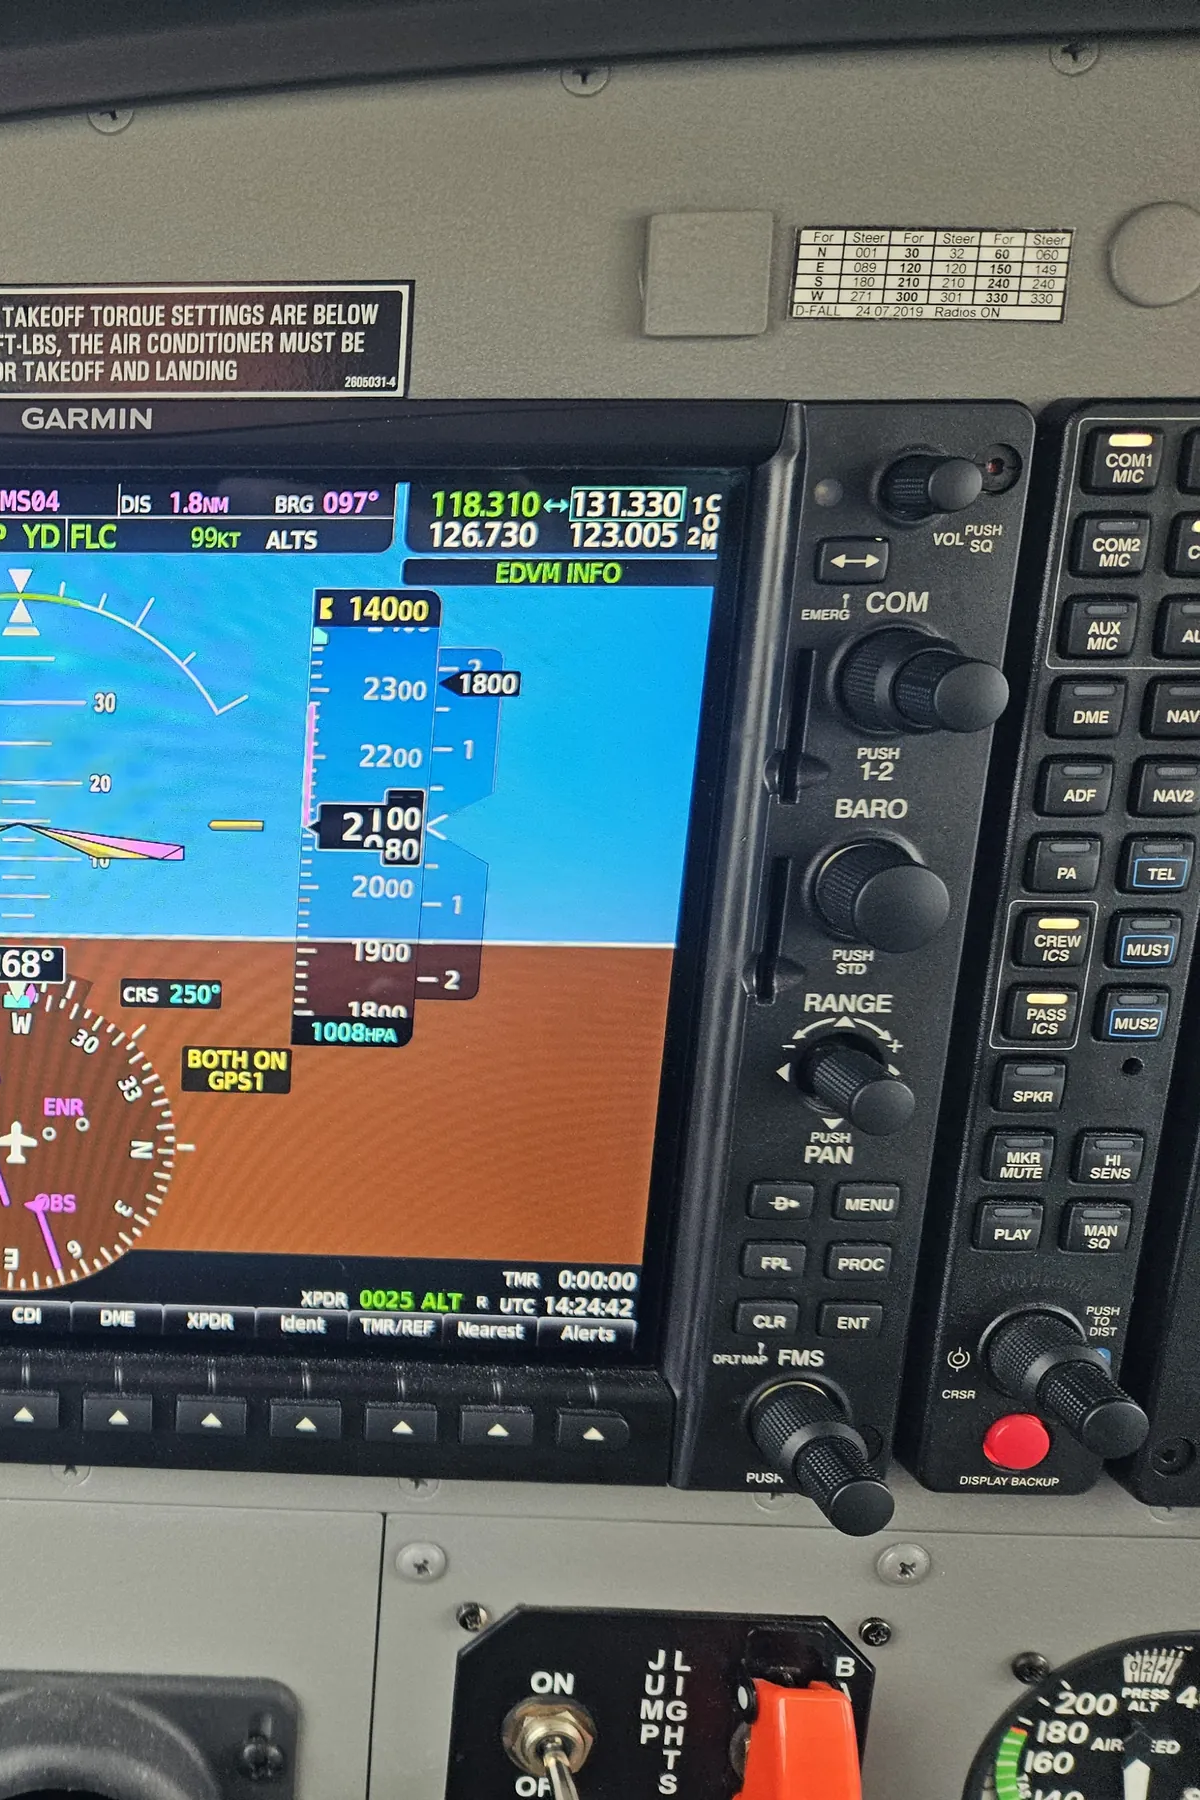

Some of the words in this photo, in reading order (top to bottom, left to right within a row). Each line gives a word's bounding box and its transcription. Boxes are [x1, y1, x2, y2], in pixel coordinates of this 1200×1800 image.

[813, 232, 834, 243] For
[852, 233, 884, 244] Steer
[903, 233, 925, 244] For
[942, 233, 975, 245] Steer
[994, 234, 1015, 245] For
[1033, 234, 1066, 246] Steer
[817, 248, 827, 258] N
[855, 248, 877, 258] 001
[904, 248, 920, 259] 30
[949, 248, 965, 259] 32
[994, 249, 1010, 260] 60
[1036, 249, 1059, 260] 060
[2, 306, 85, 328] TAKEOFF
[90, 306, 165, 328] TORQUE
[171, 305, 263, 327] SETTINGS
[269, 305, 307, 326] ARE
[312, 304, 379, 326] BELOW
[795, 305, 841, 317] D-FALL
[855, 306, 924, 317] 24.07.2019
[935, 306, 976, 318] Radios
[980, 307, 1000, 318] ON
[68, 333, 105, 355] THE
[109, 333, 141, 355] AIR
[146, 333, 274, 355] CONDITIONER
[279, 332, 336, 354] MUST
[341, 332, 365, 353] BE
[23, 361, 105, 383] TAKEOFF
[110, 361, 150, 382] AND
[155, 360, 238, 382] LANDING
[344, 375, 397, 390] 2605031-4
[20, 407, 153, 430] GARMIN
[1105, 453, 1153, 468] COM1
[121, 495, 151, 513] DIS
[169, 491, 229, 514] 1.8NM
[274, 495, 314, 514] BRG
[322, 490, 379, 514] 097°
[431, 490, 541, 518] 118.310
[572, 491, 681, 518] 131.330
[22, 523, 60, 549] YD
[71, 523, 117, 549] FLC
[190, 526, 242, 549] 99KT
[265, 529, 318, 550] ALTS
[429, 520, 539, 548] 126.730
[570, 522, 678, 548] 123.005
[1092, 538, 1141, 553] COM2
[495, 561, 562, 584] EDVM
[566, 562, 623, 584] INFO
[349, 596, 430, 622] 14000
[865, 591, 930, 613] COM
[801, 609, 851, 621] EMERG
[1087, 621, 1121, 635] AUX
[459, 673, 518, 695] 1800
[1073, 710, 1110, 724] DME
[1063, 789, 1097, 803] ADF
[1152, 789, 1195, 803] NAV2
[834, 798, 908, 819] BARO
[1034, 934, 1082, 948] CREW
[1126, 943, 1170, 956] MUS1
[123, 987, 159, 1003] CRS
[169, 984, 221, 1004] 250°
[803, 993, 893, 1014] RANGE
[1026, 1008, 1067, 1021] PASS
[311, 1022, 398, 1044] 1008HPA
[187, 1049, 248, 1069] BOTH
[253, 1051, 288, 1071] ON
[207, 1071, 264, 1092] GPS1
[803, 1146, 854, 1165] PAN
[844, 1199, 895, 1212] MENU
[994, 1228, 1032, 1241] PLAY
[837, 1258, 885, 1272] PROC
[300, 1290, 349, 1309] XPDR
[359, 1289, 416, 1311] 0025
[420, 1292, 465, 1313] ALT
[499, 1297, 536, 1314] UTC
[544, 1296, 635, 1317] 14:24:42
[11, 1307, 42, 1325] CDI
[280, 1314, 328, 1334] Ident
[359, 1318, 436, 1336] TMR/REF
[457, 1321, 525, 1341] Nearest
[560, 1325, 617, 1343] Alerts
[777, 1349, 825, 1367] FMS
[941, 1389, 976, 1400] CRSR
[959, 1475, 1009, 1487] DISPLAY
[1011, 1476, 1060, 1488] BACKUP
[530, 1671, 575, 1696] ON
[1121, 1687, 1171, 1701] PRESS
[1054, 1691, 1118, 1717] 200
[1127, 1701, 1160, 1713] ALT
